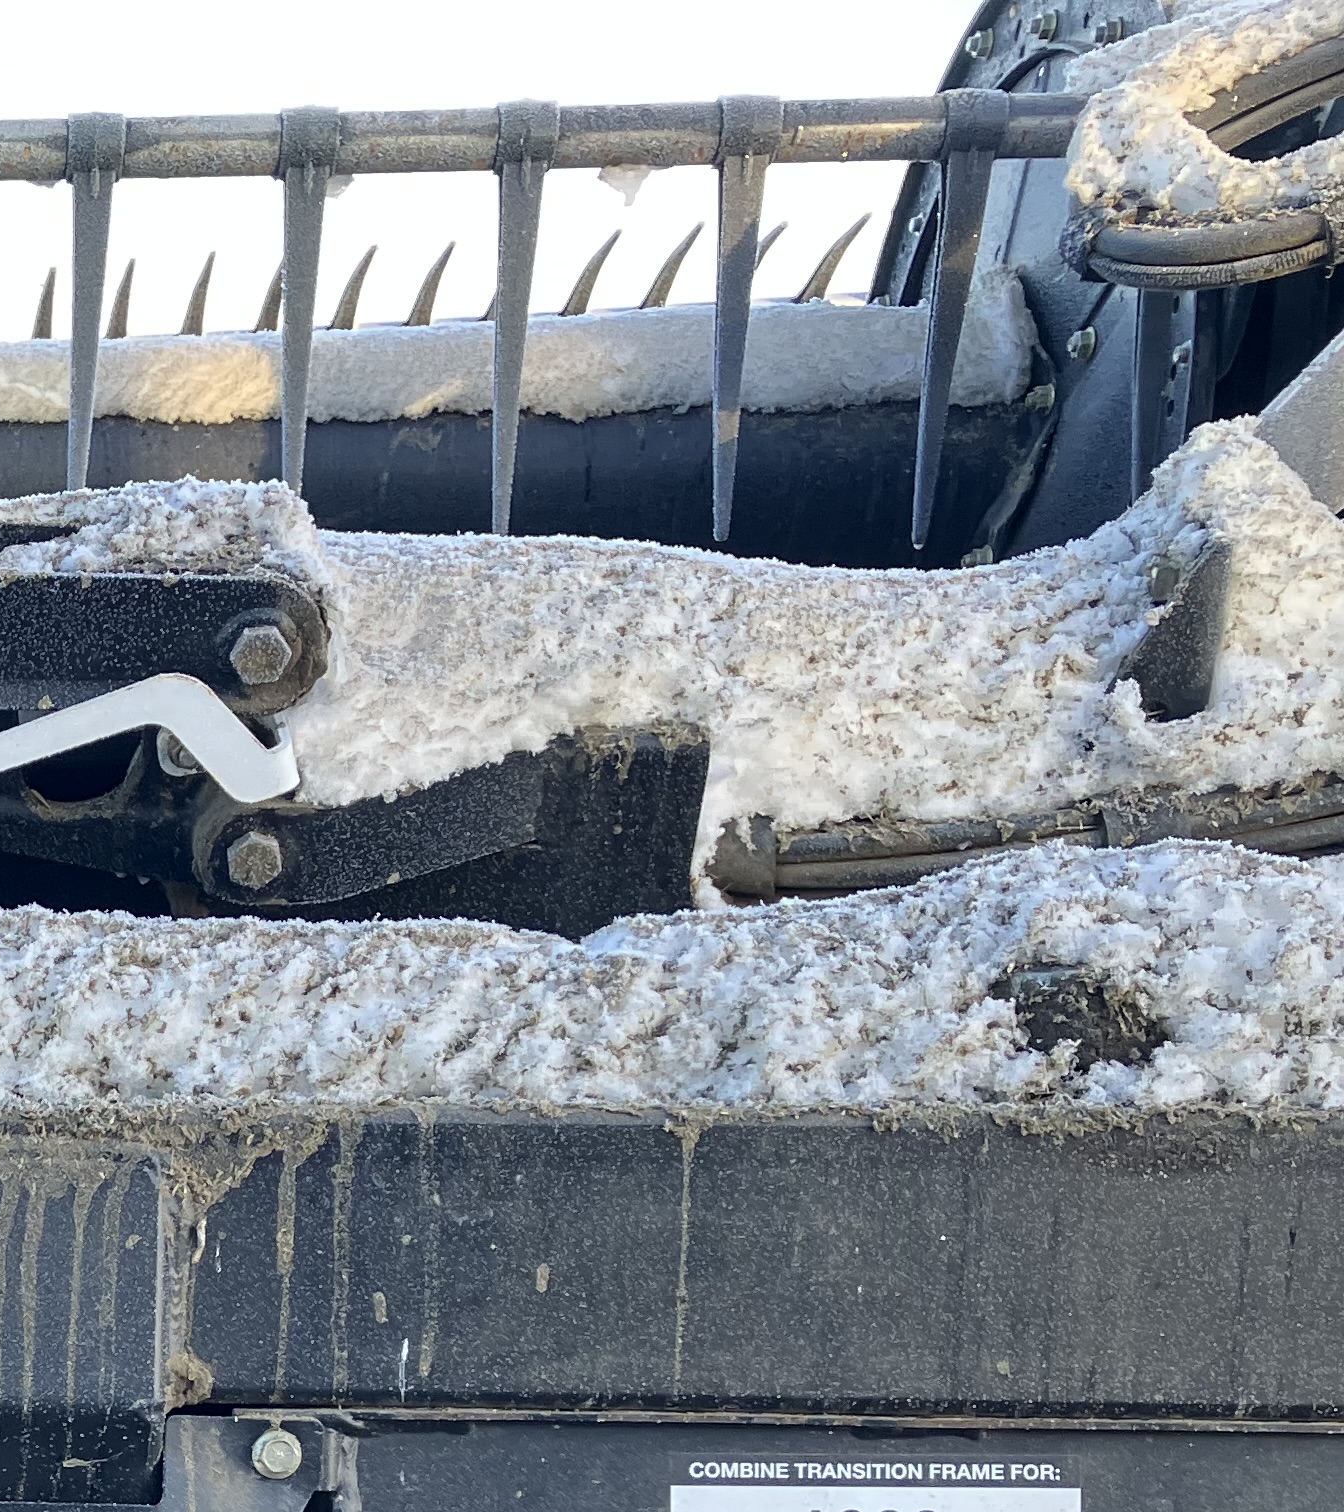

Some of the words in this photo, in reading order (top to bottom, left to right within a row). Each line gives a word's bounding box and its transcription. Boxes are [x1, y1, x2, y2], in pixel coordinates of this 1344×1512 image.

[689, 1461, 790, 1480] COMBINE
[794, 1462, 924, 1481] TRANSITION
[929, 1463, 1005, 1481] FRAME
[1011, 1463, 1062, 1482] FOR:
